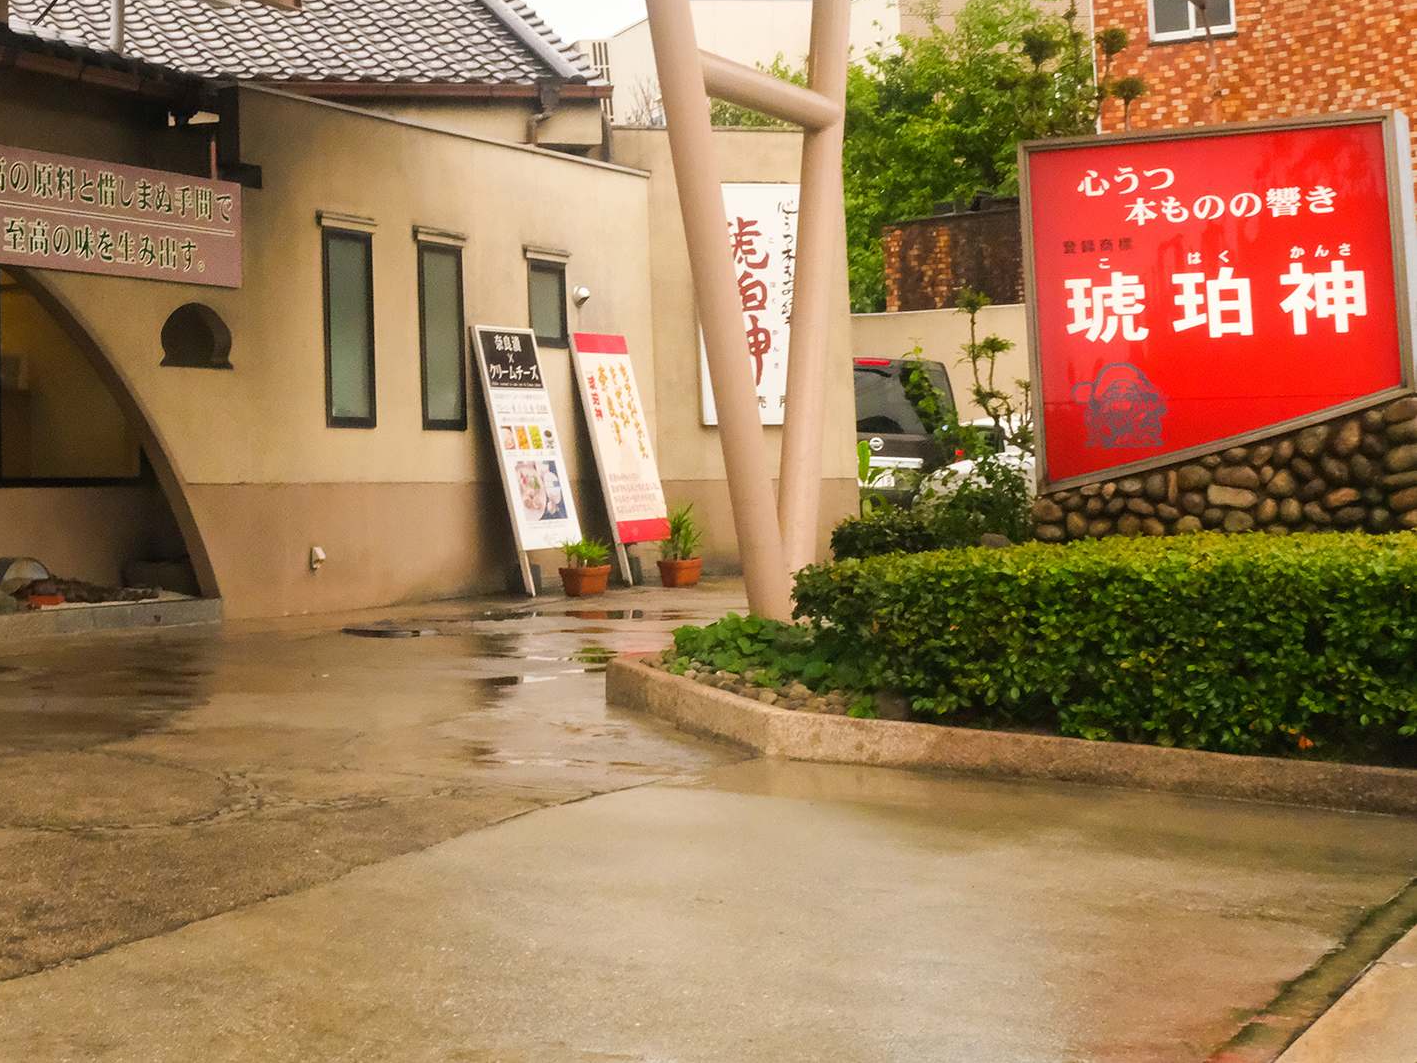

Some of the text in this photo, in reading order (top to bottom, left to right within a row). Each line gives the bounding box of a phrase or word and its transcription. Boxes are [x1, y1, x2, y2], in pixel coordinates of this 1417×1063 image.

[1076, 166, 1175, 198] 心うつ
[1124, 185, 1338, 226] 本ものの響き
[2, 216, 206, 274] 至高の味を生み出す。
[1064, 260, 1368, 343] 琥珀神
[493, 334, 522, 352] 奈良漬
[489, 363, 540, 381] クリームチーズ
